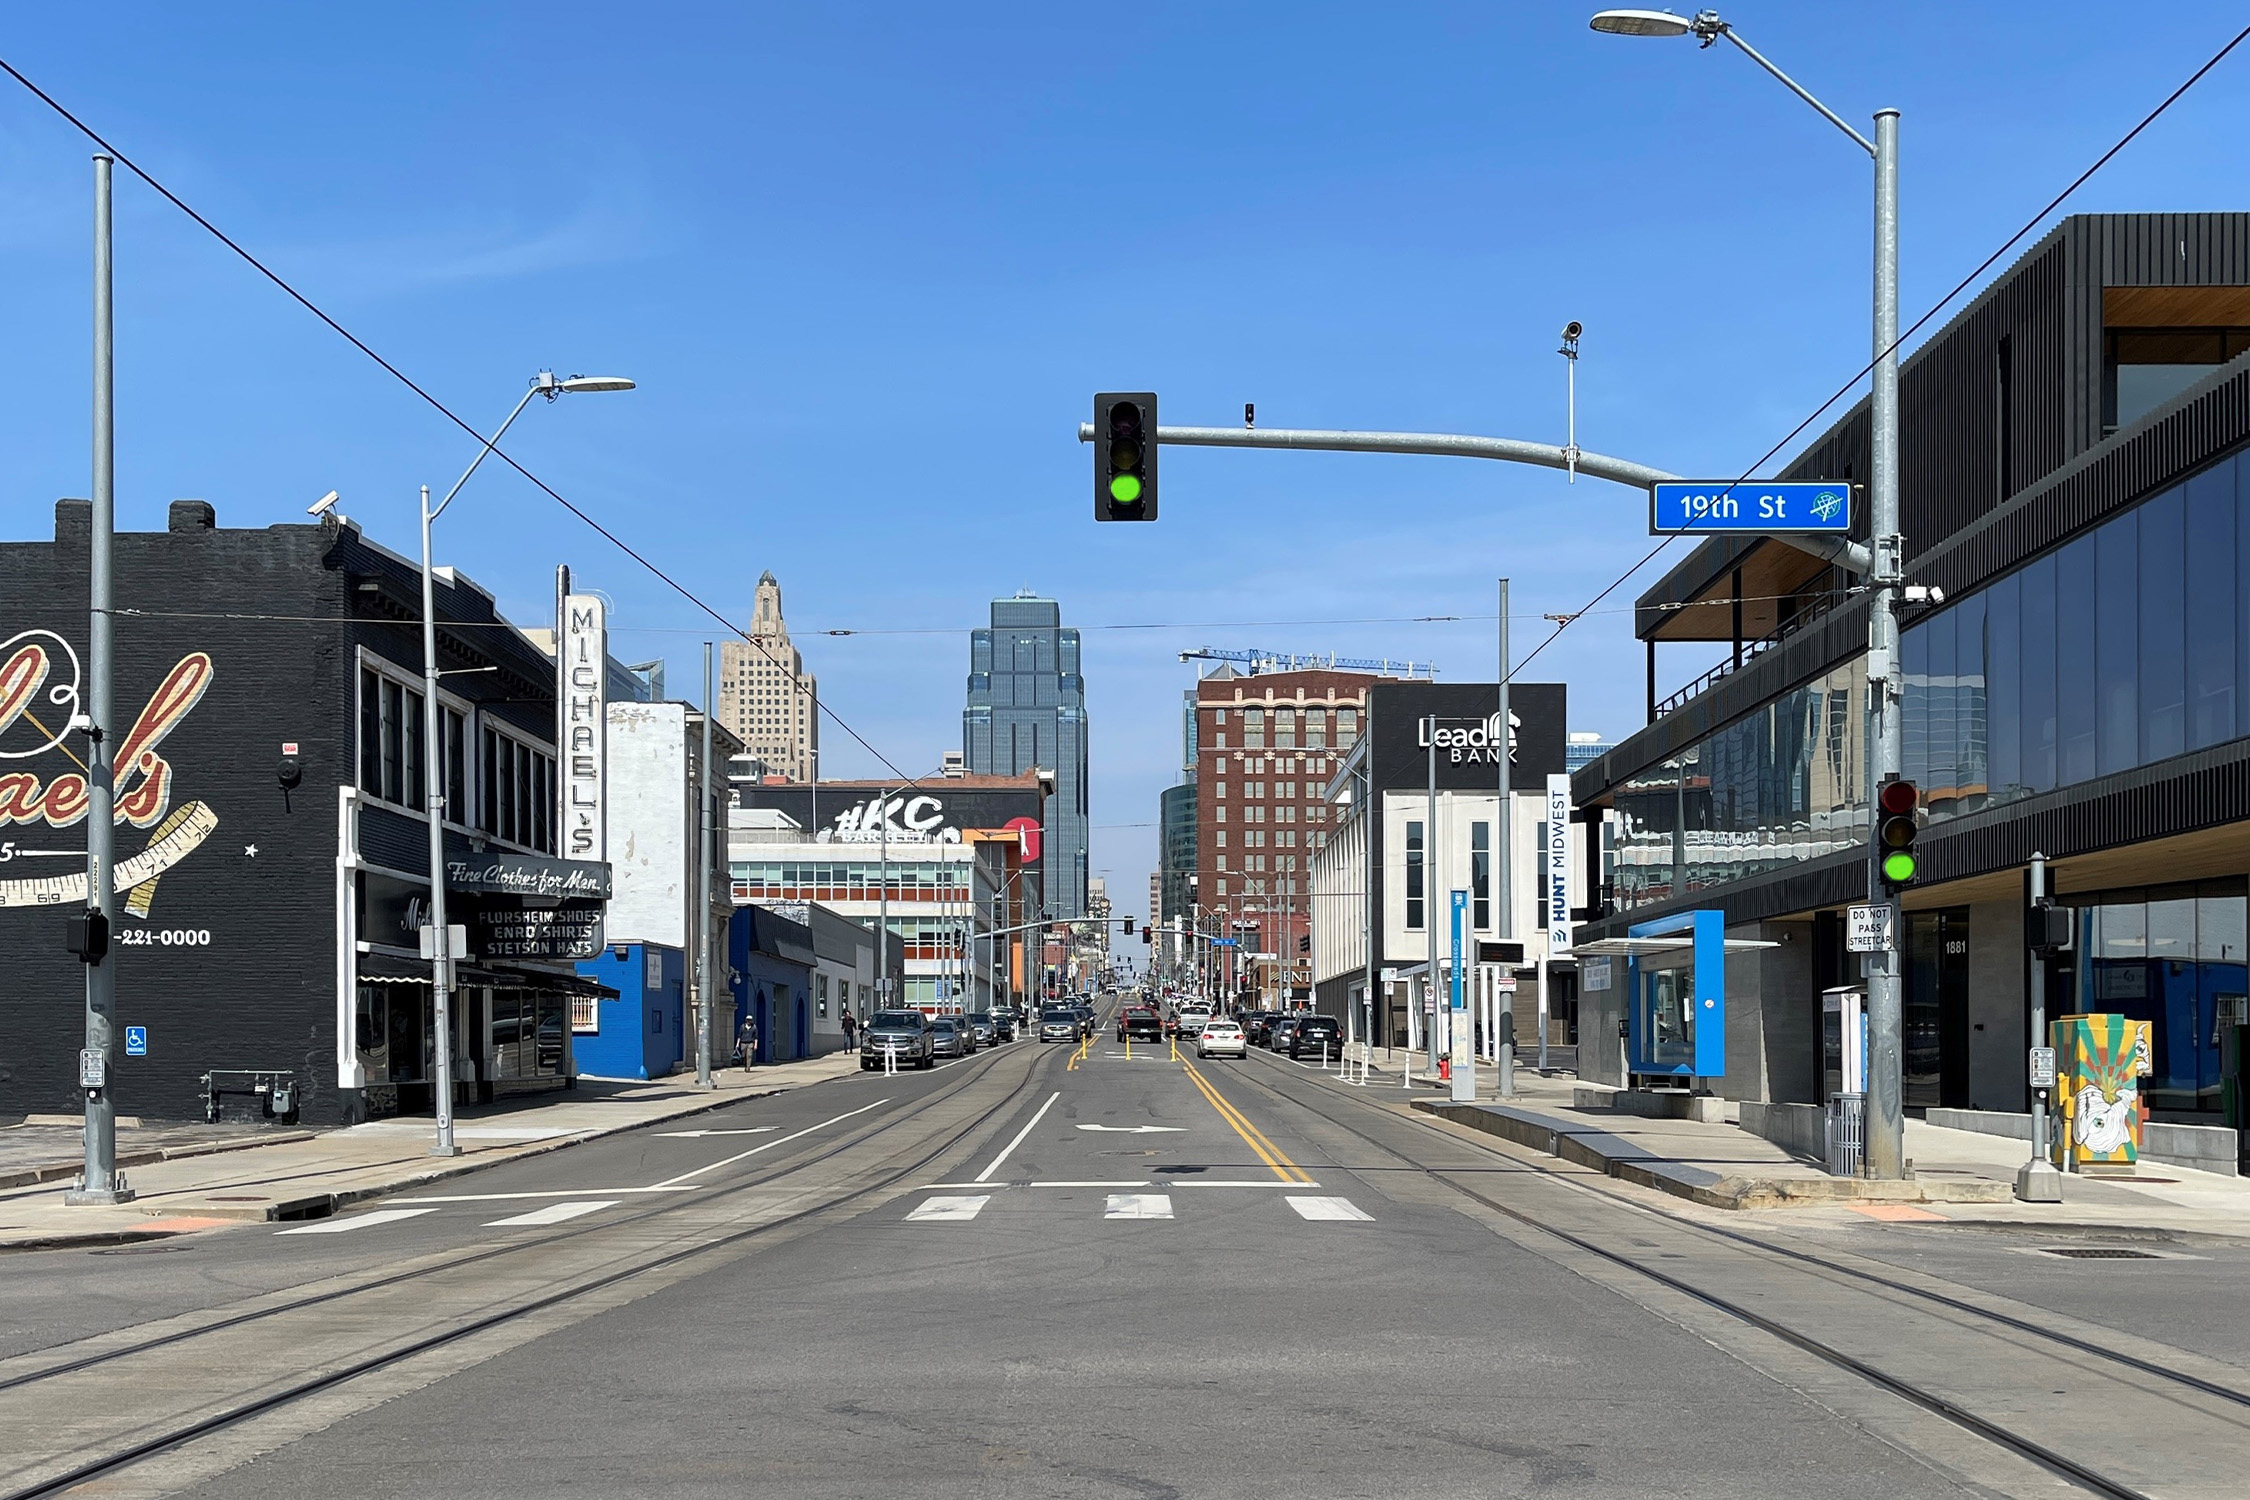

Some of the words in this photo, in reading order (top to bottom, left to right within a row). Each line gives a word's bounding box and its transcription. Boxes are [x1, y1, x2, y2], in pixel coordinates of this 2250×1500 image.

[1680, 494, 1739, 519] 19th
[1759, 495, 1786, 519] St
[571, 607, 598, 854] MICHAEL'S
[1419, 717, 1488, 747] Lead
[1451, 748, 1518, 763] BANK
[1552, 790, 1565, 868] MIDWEST
[448, 862, 482, 882] Fine
[483, 865, 538, 886] Clothes
[537, 868, 562, 893] for
[1552, 874, 1565, 922] HUNT
[478, 911, 553, 924] FLORSHEIM
[559, 909, 600, 923] SHOES
[1853, 911, 1865, 920] DO
[1870, 909, 1887, 919] NOT
[543, 925, 592, 938] SHIRTS
[1858, 924, 1882, 933] PASS
[488, 941, 550, 954] STETSON
[557, 941, 592, 953] HATS
[1849, 936, 1892, 946] STREETCAR
[1946, 940, 1966, 954] 1881
[1452, 938, 1460, 979] Crossroads
